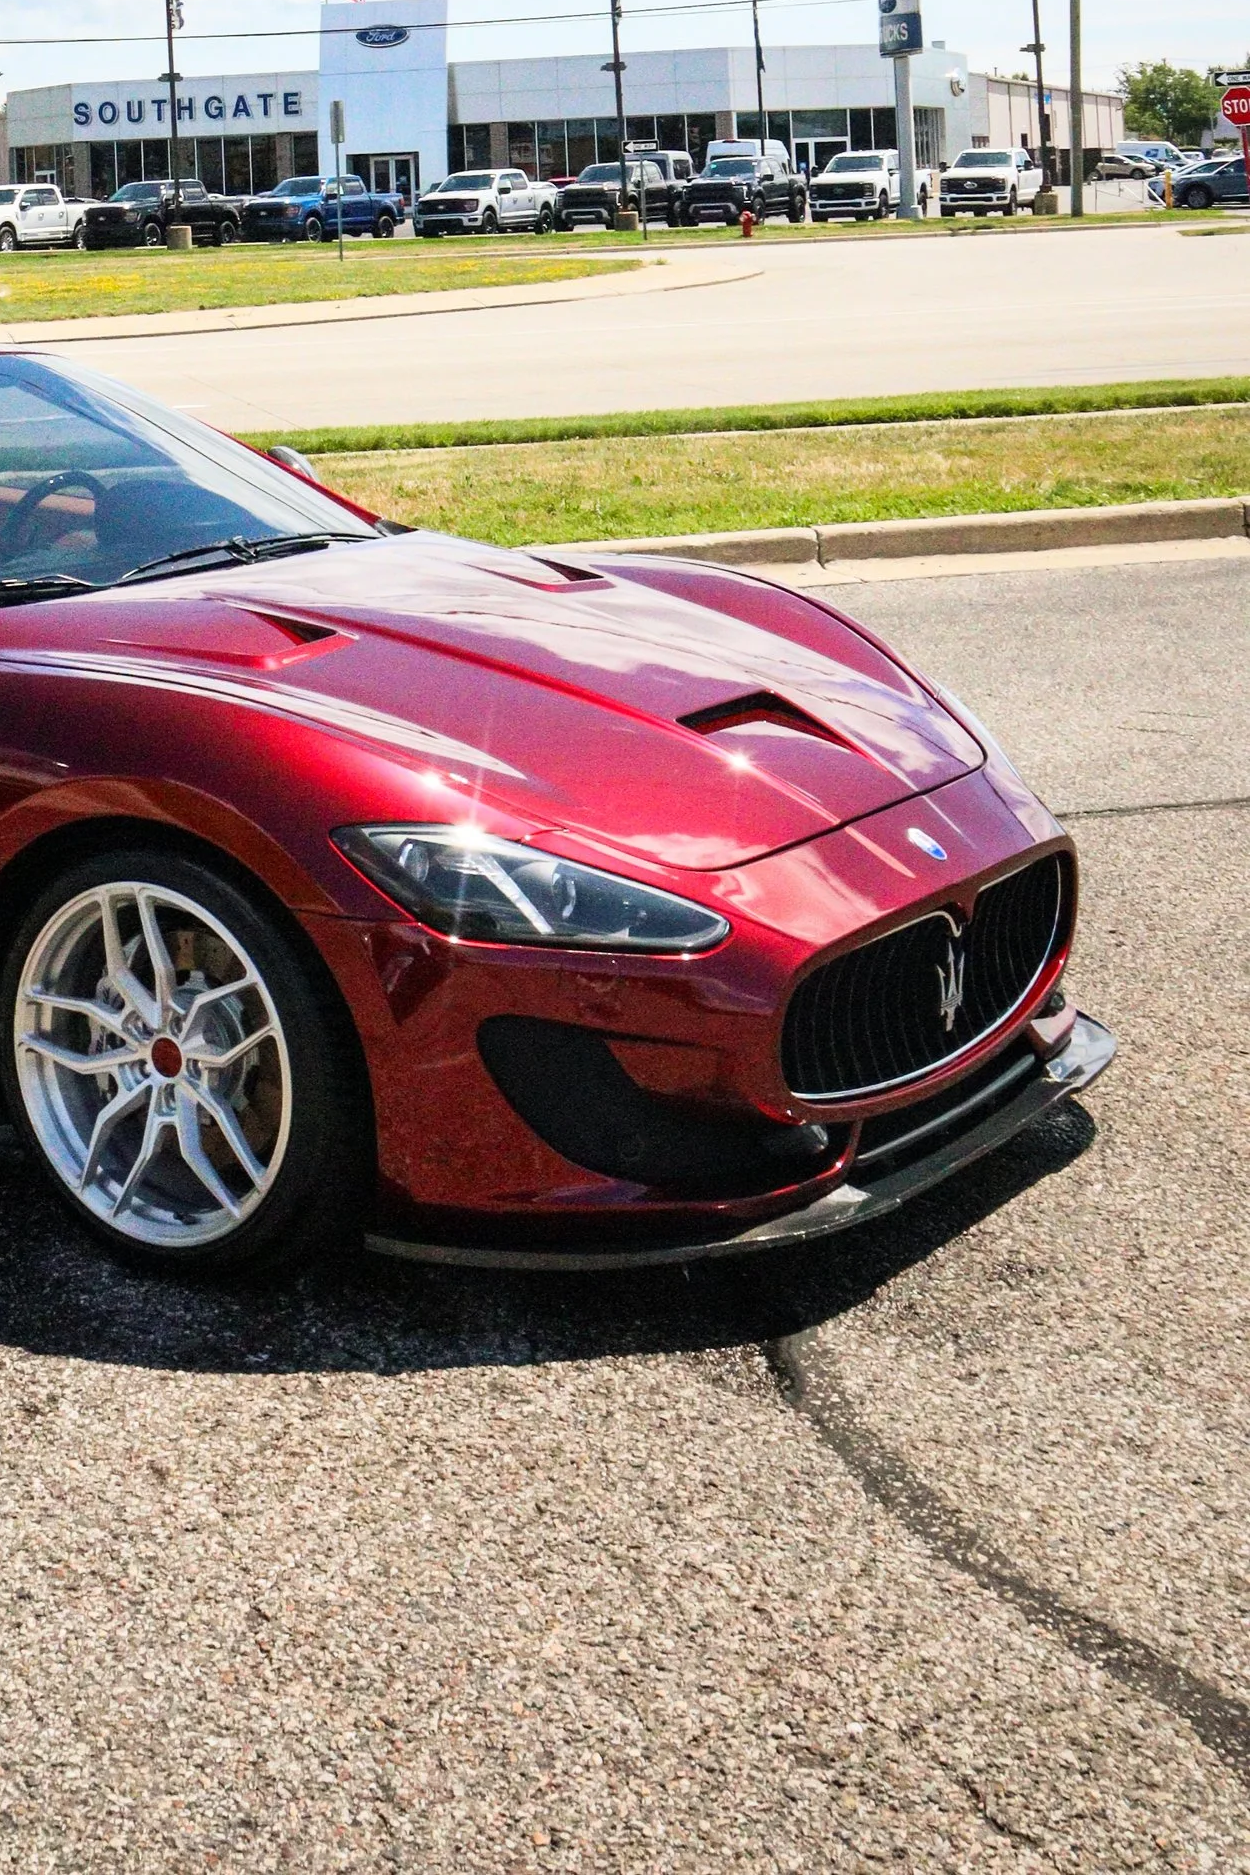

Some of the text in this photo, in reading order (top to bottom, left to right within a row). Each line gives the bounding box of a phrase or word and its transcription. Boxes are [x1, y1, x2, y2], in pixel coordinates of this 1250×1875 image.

[366, 30, 396, 42] Ford
[73, 92, 302, 126] SOUTHGATE
[1223, 98, 1250, 115] STO
